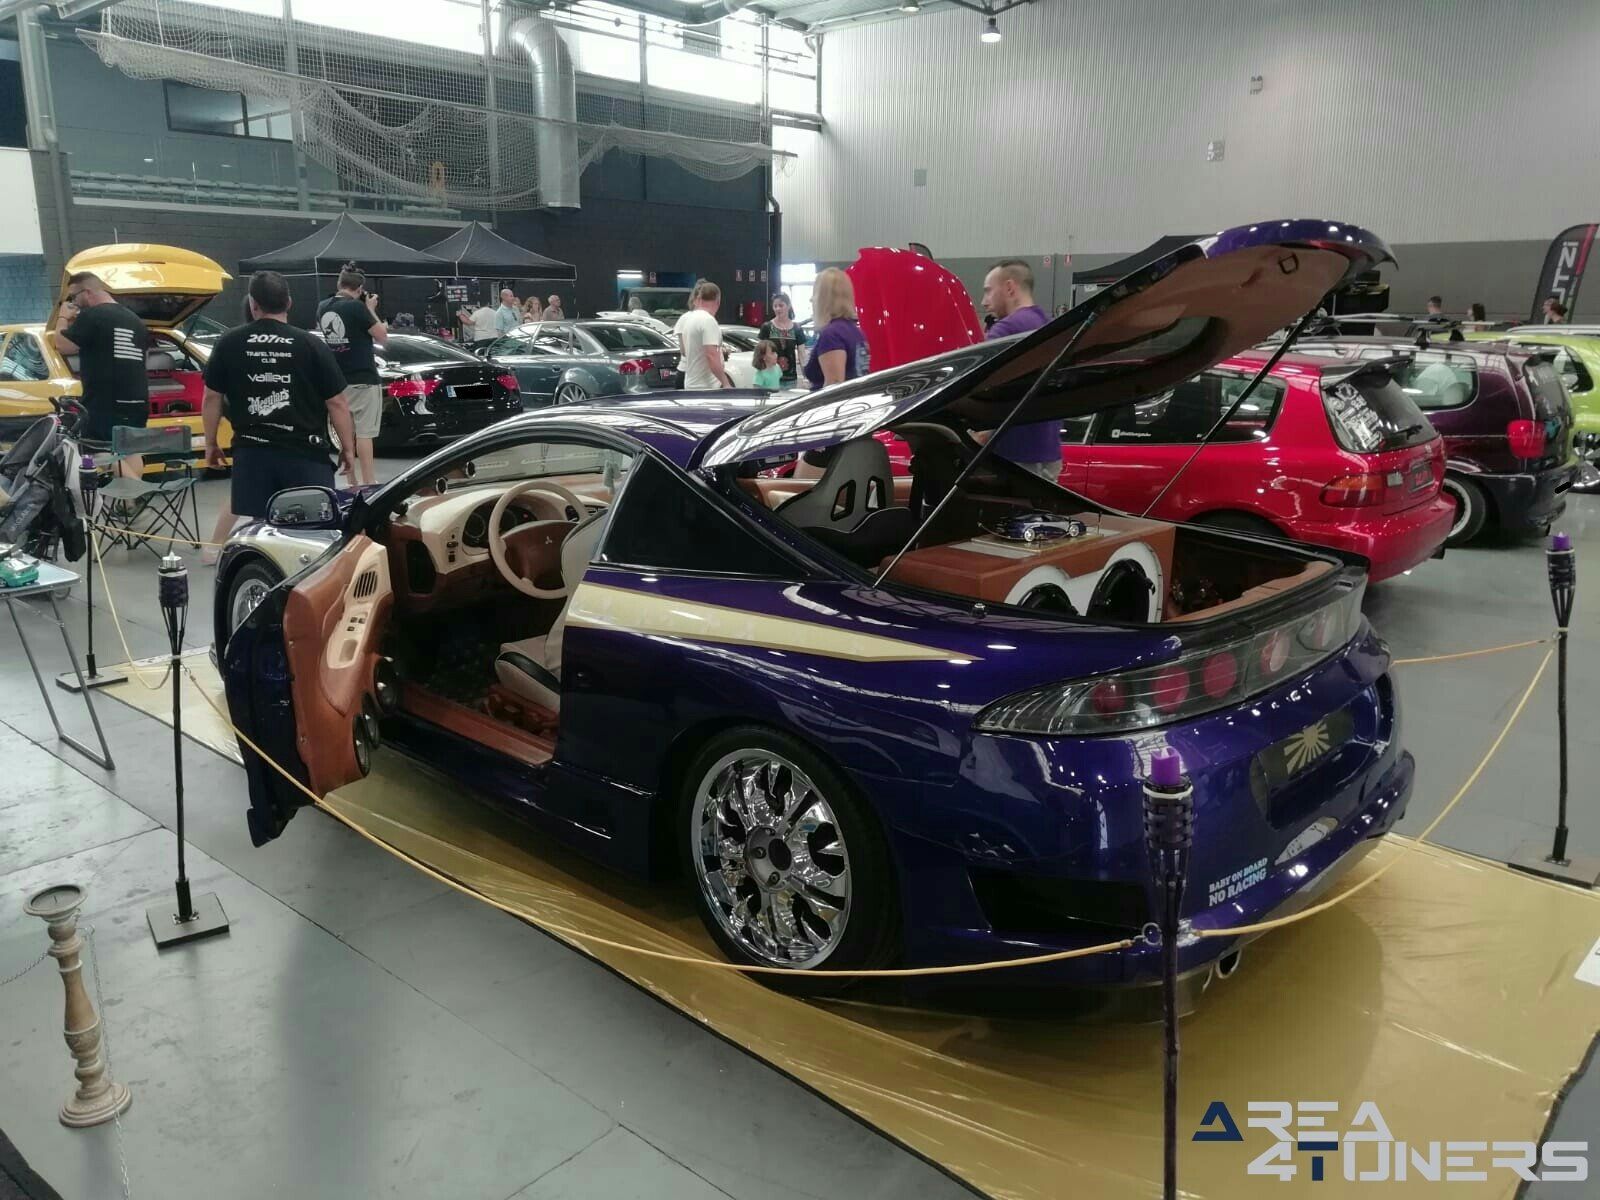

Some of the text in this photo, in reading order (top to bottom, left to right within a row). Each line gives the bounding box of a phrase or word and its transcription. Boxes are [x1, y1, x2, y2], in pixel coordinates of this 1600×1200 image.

[247, 334, 294, 344] 207RC
[1208, 857, 1268, 893] BABY ON BOARD
[1208, 868, 1267, 907] NO RACING
